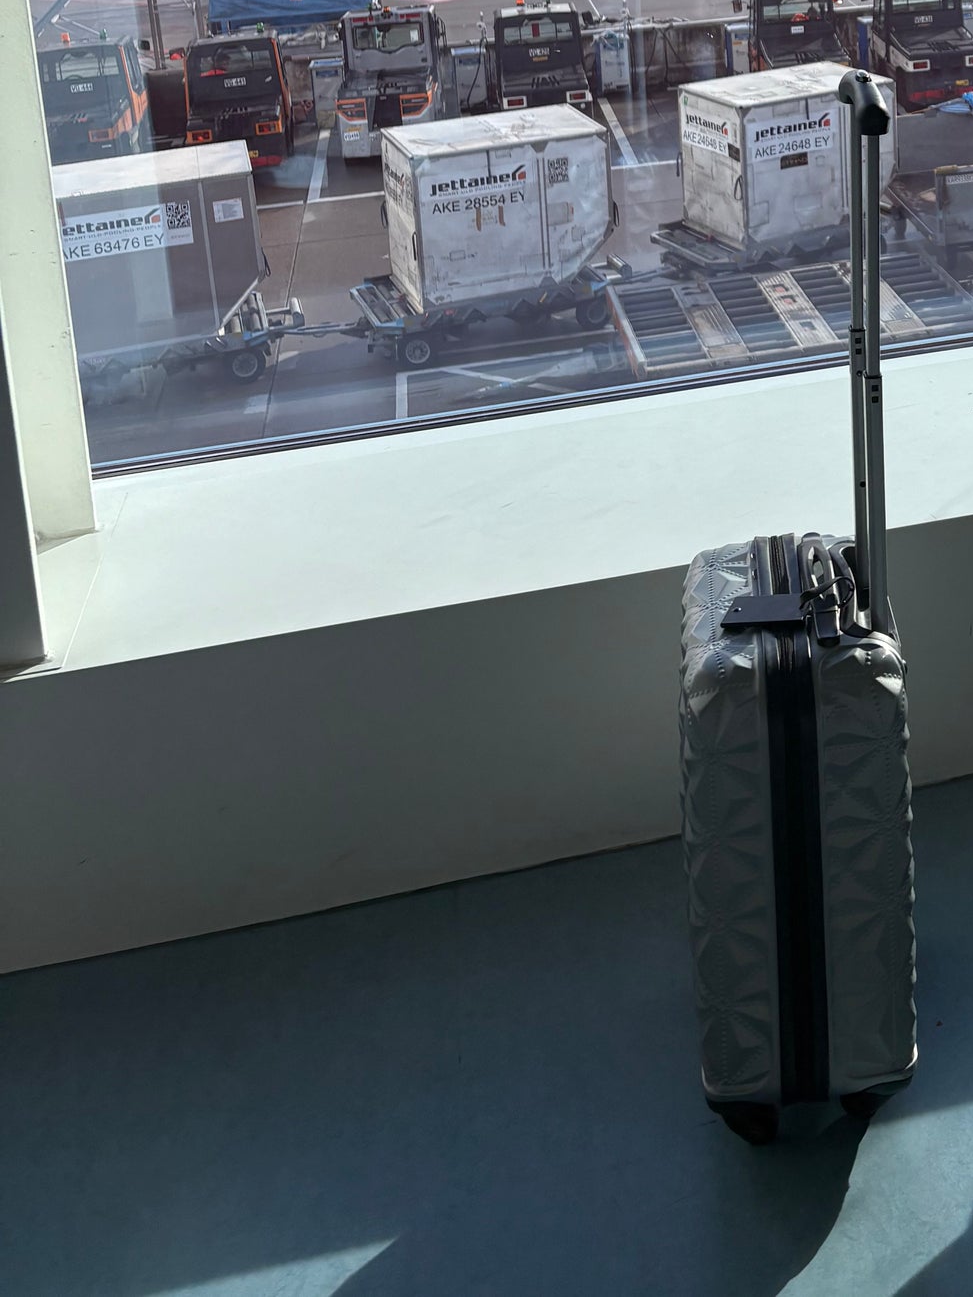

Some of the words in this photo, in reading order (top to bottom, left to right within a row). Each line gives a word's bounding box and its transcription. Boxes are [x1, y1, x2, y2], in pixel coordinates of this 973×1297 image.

[686, 113, 729, 136] jettainer
[754, 112, 831, 143] jettainer
[683, 130, 698, 144] AKE
[697, 132, 718, 150] 24648
[718, 140, 728, 153] EY
[754, 144, 778, 159] AKE
[778, 138, 812, 154] 24648
[814, 135, 831, 148] EY
[430, 164, 527, 197] jettainer
[432, 201, 461, 215] AKE
[465, 197, 506, 209] 28554
[510, 191, 526, 203] EY
[62, 207, 161, 237] ettainer
[94, 237, 140, 255] 63476
[143, 233, 165, 247] EY
